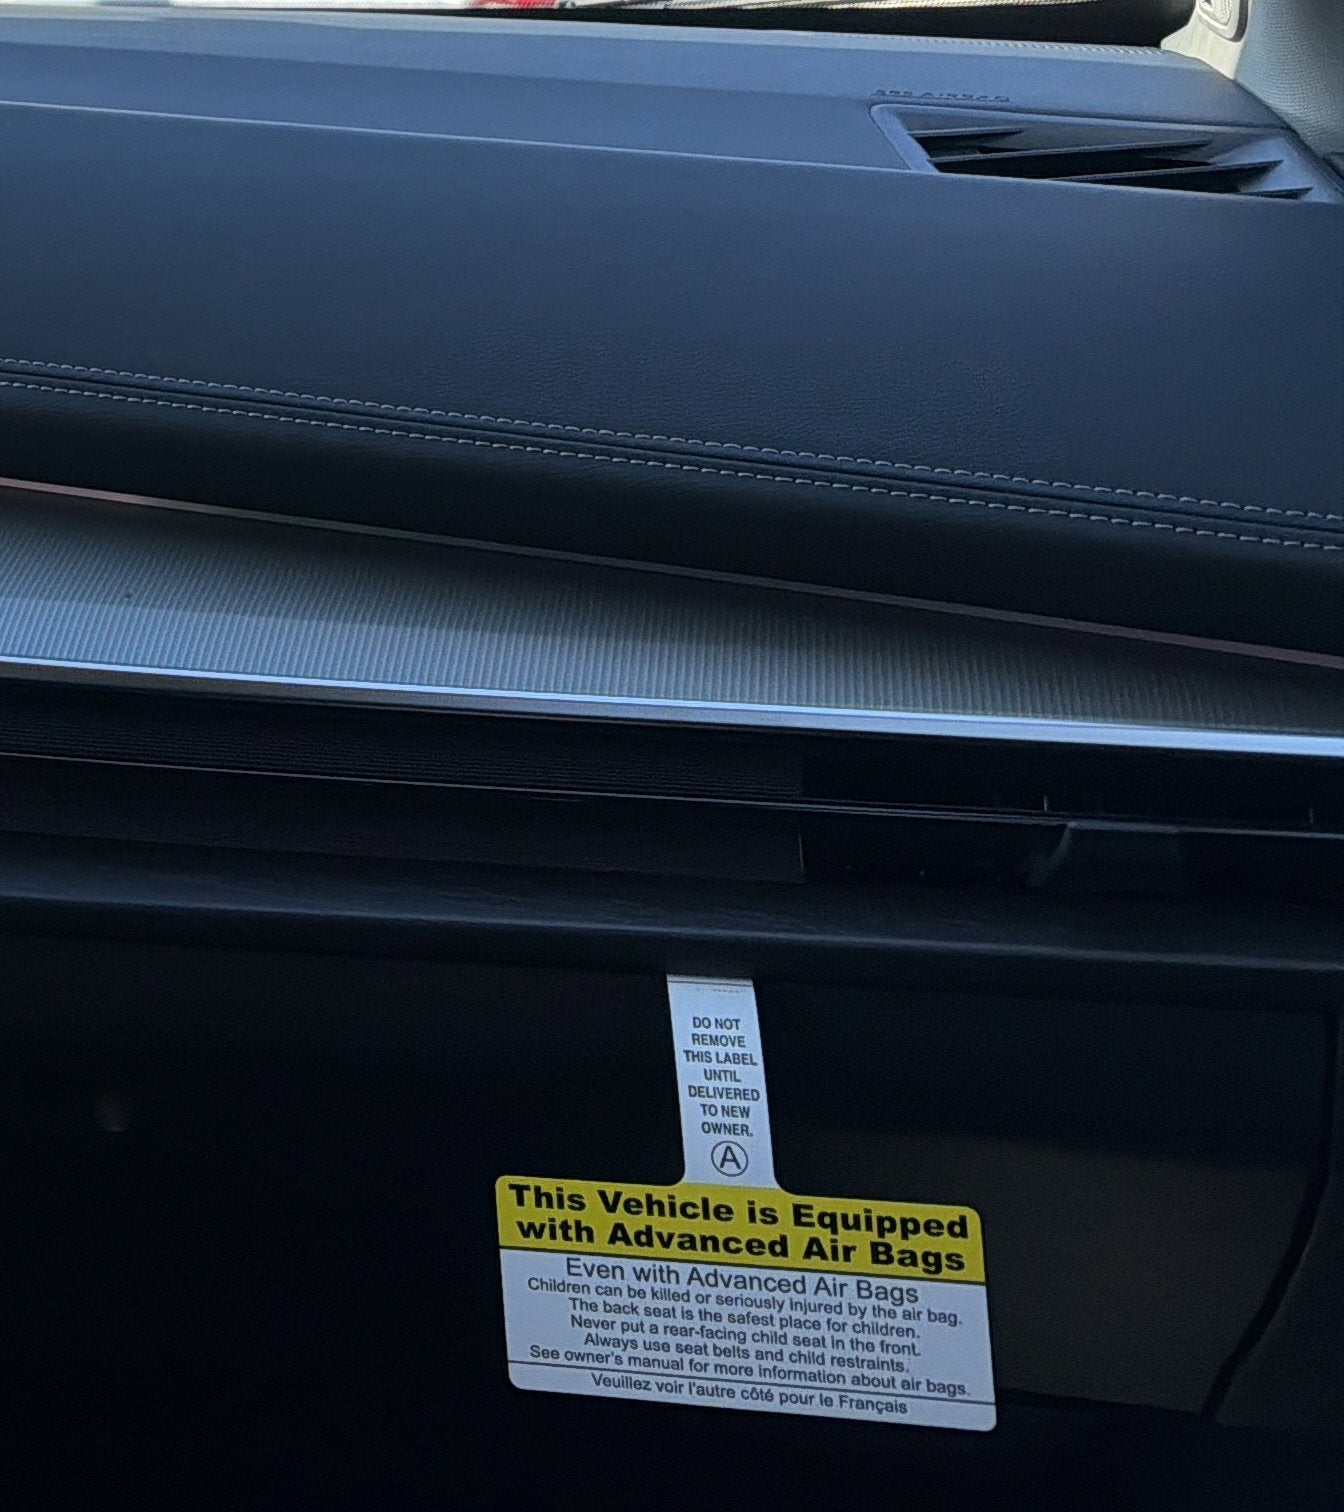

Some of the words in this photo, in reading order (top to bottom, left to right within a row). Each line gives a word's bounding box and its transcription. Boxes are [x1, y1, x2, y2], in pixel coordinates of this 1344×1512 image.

[691, 1033, 746, 1048] REMOVE
[692, 1016, 711, 1030] DO
[715, 1017, 741, 1031] NOT
[683, 1050, 712, 1064] THIS
[715, 1052, 758, 1067] LABEL
[704, 1068, 742, 1083] UNTIL
[688, 1085, 761, 1102] DELIVERED
[700, 1103, 718, 1117] TO
[721, 1105, 751, 1119] NEW
[701, 1121, 754, 1137] OWNER.
[719, 1146, 742, 1170] A
[508, 1183, 586, 1212] This
[597, 1189, 734, 1222] Vehicle
[747, 1199, 779, 1225] is
[791, 1203, 969, 1241] Equipped
[516, 1217, 595, 1244] with
[607, 1222, 789, 1258] Advanced
[802, 1236, 857, 1262] Air
[869, 1240, 965, 1275] Bags
[527, 1276, 590, 1295] Children
[595, 1285, 623, 1297] can
[627, 1284, 646, 1300] be
[651, 1287, 690, 1304] killed
[695, 1293, 712, 1305] or
[715, 1294, 785, 1312] seriously
[790, 1298, 843, 1316] injured
[848, 1303, 867, 1319] by
[872, 1305, 897, 1319] the
[902, 1308, 923, 1321] air
[927, 1309, 963, 1327] bag.
[566, 1257, 625, 1281] Even
[632, 1263, 680, 1285] with
[687, 1266, 806, 1294] Advanced
[814, 1276, 849, 1298] Air
[856, 1279, 920, 1306] Bags
[568, 1297, 599, 1313] The
[603, 1300, 640, 1316] back
[644, 1304, 677, 1318] seat
[680, 1307, 694, 1321] is
[698, 1308, 723, 1323] the
[727, 1311, 775, 1327] safest
[779, 1315, 822, 1330] place
[826, 1319, 847, 1333] for
[851, 1321, 921, 1339] children.
[571, 1315, 616, 1331] Never
[620, 1319, 645, 1335] put
[649, 1323, 659, 1334] a
[663, 1324, 747, 1345] rear-facing
[751, 1329, 788, 1346] child
[792, 1335, 827, 1349] seat
[831, 1336, 846, 1350] in
[850, 1337, 876, 1353] the
[879, 1340, 922, 1357] front.
[529, 1344, 560, 1361] See
[564, 1350, 624, 1366] owner's
[627, 1355, 684, 1371] manual
[688, 1359, 710, 1373] for
[714, 1364, 754, 1377] more
[758, 1365, 846, 1385] information
[851, 1374, 896, 1389] about
[901, 1378, 922, 1391] air
[926, 1380, 971, 1397] bags.
[584, 1332, 639, 1352] Always
[642, 1341, 671, 1353] use
[675, 1342, 709, 1356] seat
[713, 1344, 750, 1359] belts
[755, 1348, 784, 1362] and
[788, 1350, 825, 1366] child
[830, 1355, 910, 1373] restraints.
[591, 1372, 653, 1392] Veuillez
[655, 1381, 685, 1395] voir
[688, 1382, 736, 1400] l'autre
[740, 1388, 775, 1402] côté
[779, 1391, 816, 1406] pour
[819, 1393, 834, 1407] le
[839, 1395, 908, 1415] Français
